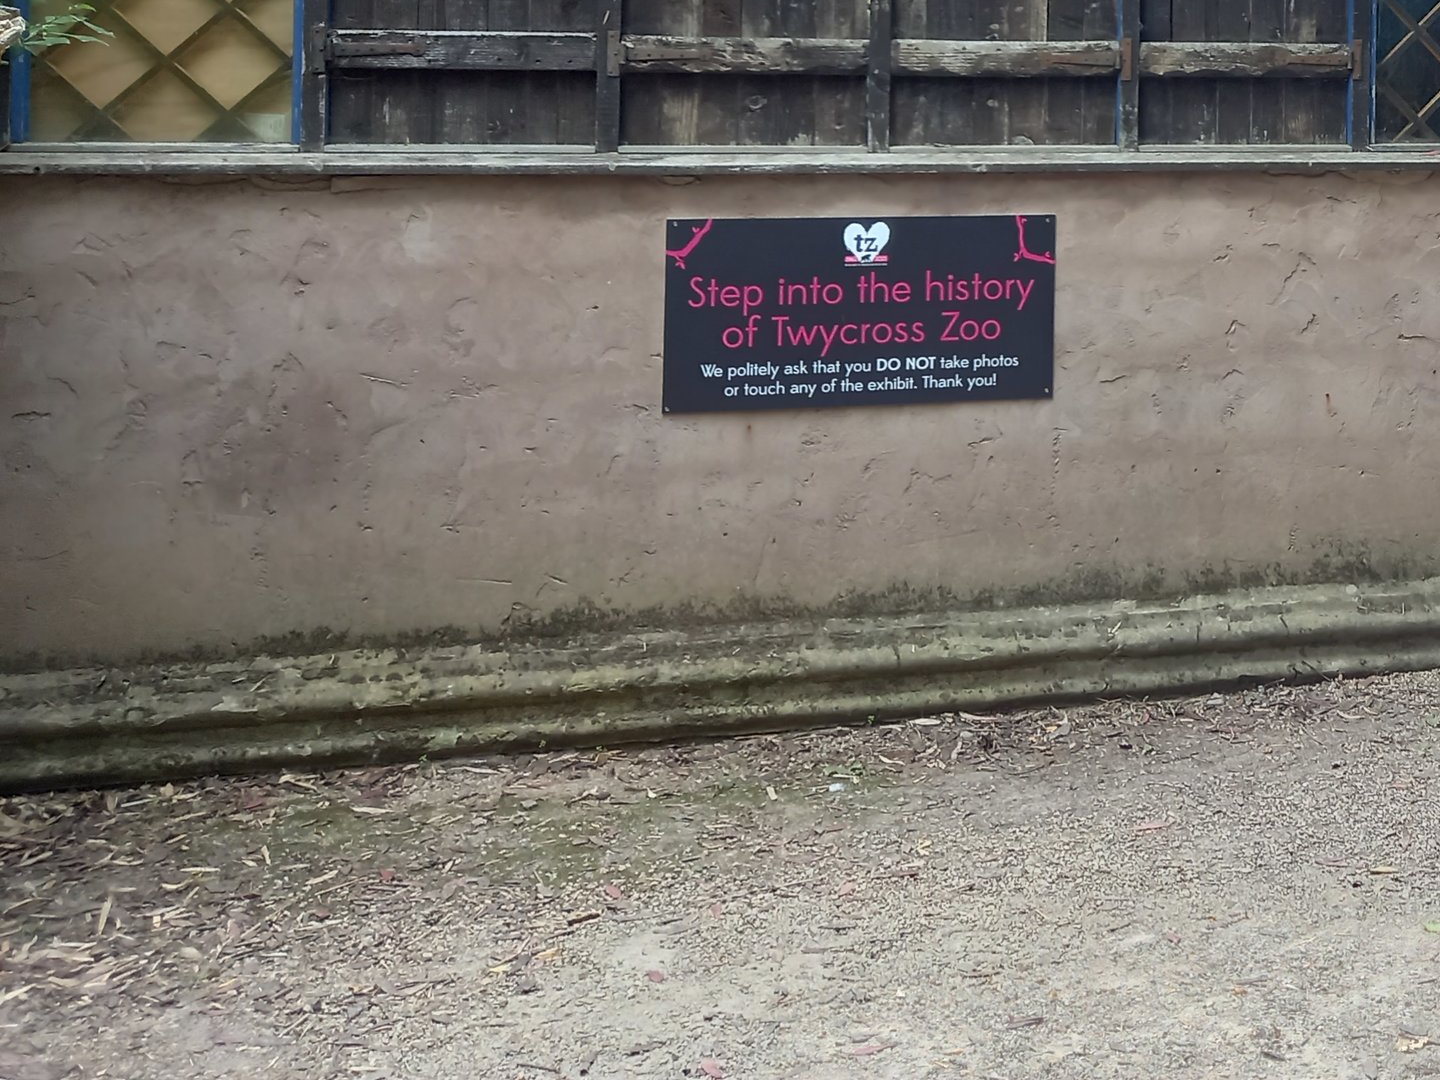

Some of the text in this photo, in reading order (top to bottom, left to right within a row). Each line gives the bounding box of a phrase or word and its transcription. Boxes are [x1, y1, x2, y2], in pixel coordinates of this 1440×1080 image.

[853, 233, 879, 253] tz
[687, 270, 1035, 316] Step into the history
[722, 311, 1001, 357] of Twycross Zoo
[700, 353, 1019, 381] We politely ask that you DO NOT take photos
[724, 372, 997, 398] or touch any of the exhibit. Thank you!
